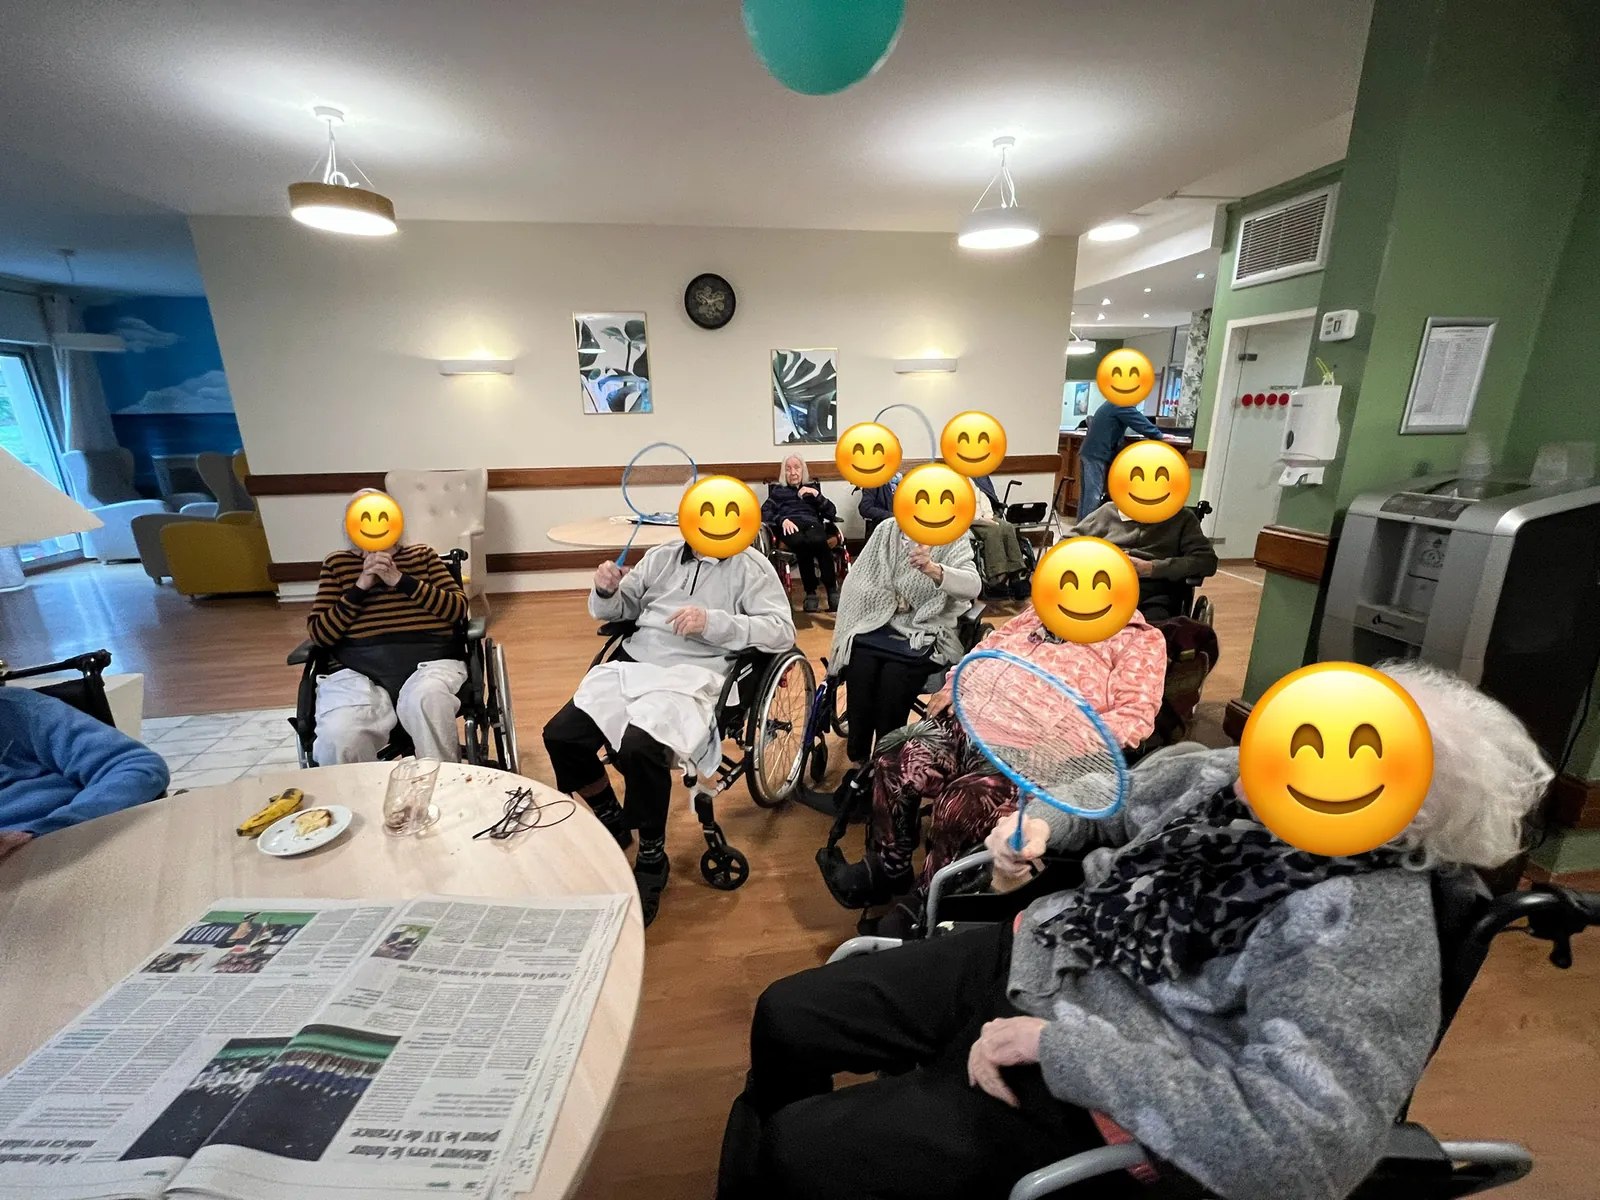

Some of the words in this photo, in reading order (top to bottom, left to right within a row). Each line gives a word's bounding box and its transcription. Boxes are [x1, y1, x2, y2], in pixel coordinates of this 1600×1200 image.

[350, 1128, 402, 1142] France
[404, 1130, 421, 1143] de
[446, 1131, 461, 1144] le
[389, 1146, 406, 1159] le
[407, 1148, 438, 1158] vers
[440, 1149, 492, 1162] Retour
